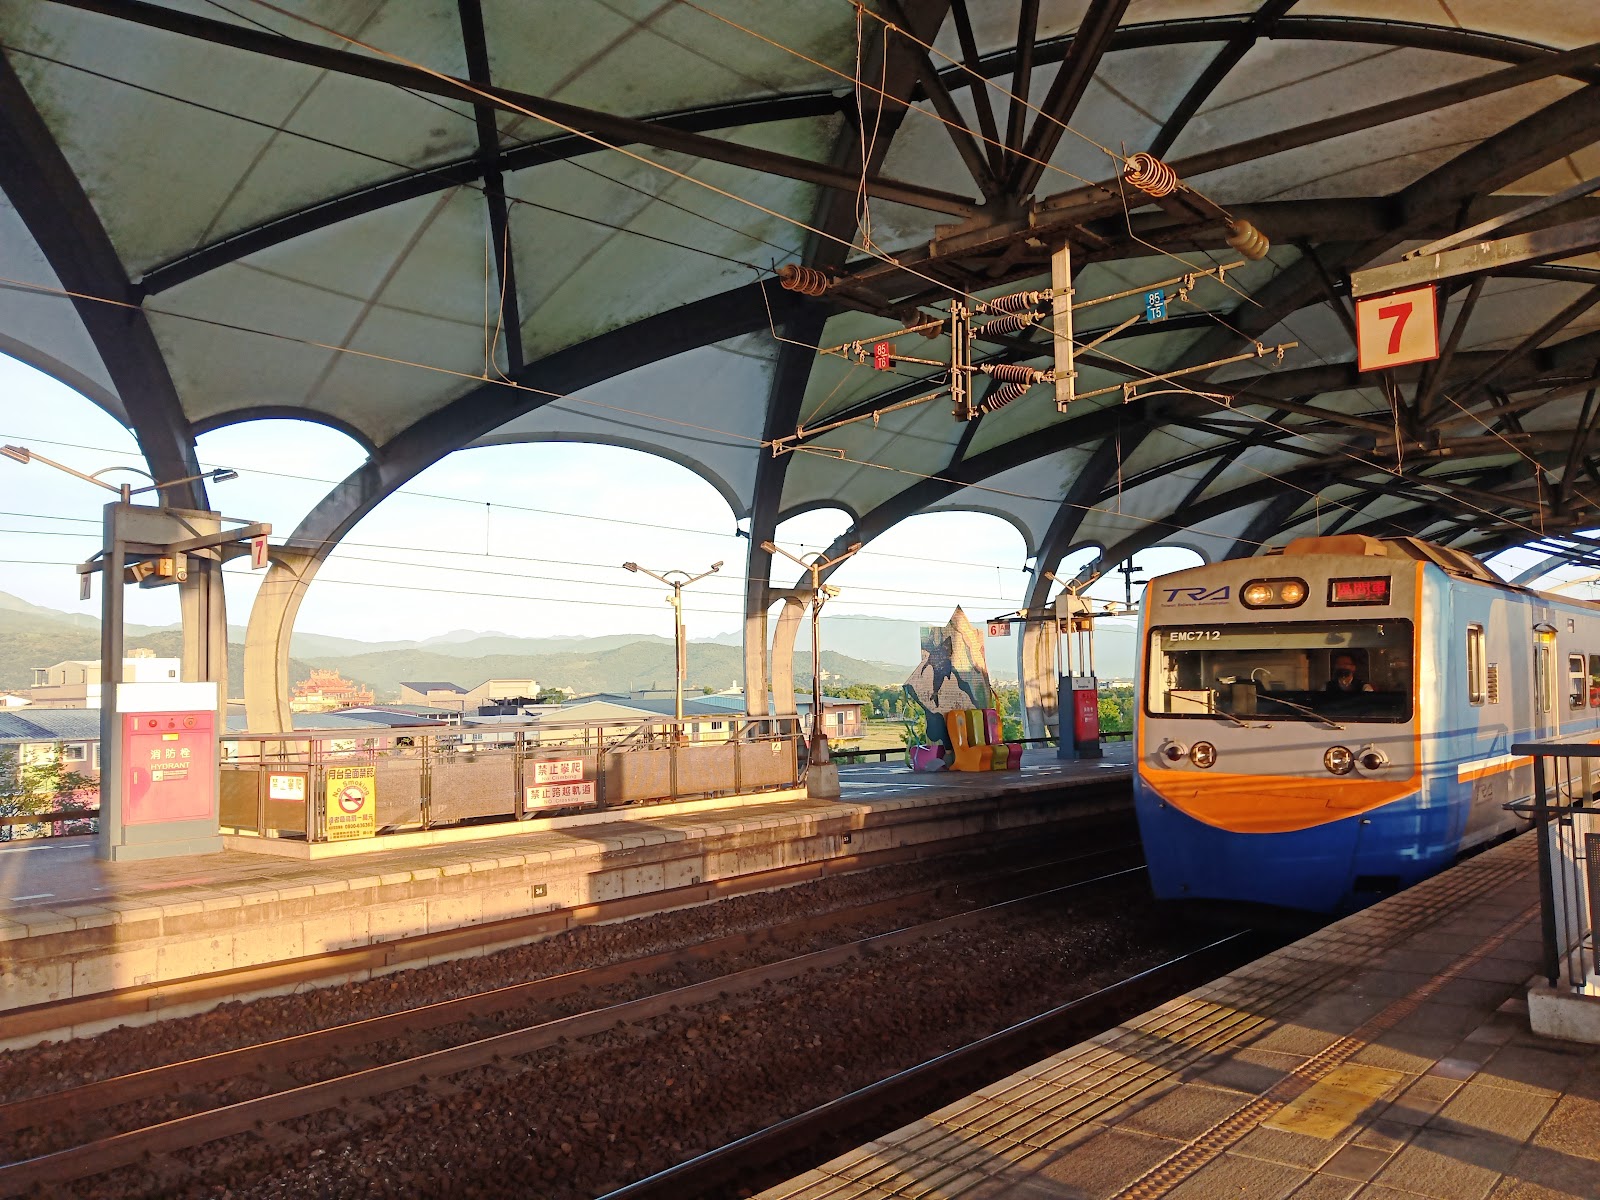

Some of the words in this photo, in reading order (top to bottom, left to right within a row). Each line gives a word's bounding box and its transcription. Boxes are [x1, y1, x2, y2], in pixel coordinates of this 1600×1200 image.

[1149, 292, 1161, 305] 85
[1150, 306, 1162, 319] T5
[1379, 302, 1413, 355] 7
[877, 344, 886, 355] 85
[255, 540, 263, 566] 7
[82, 577, 89, 597] 7
[1163, 586, 1230, 602] TRA
[990, 625, 997, 636] 6
[1170, 631, 1221, 642] EMC712
[150, 747, 191, 760] 消防栓
[150, 761, 191, 770] HYDRANT
[342, 780, 370, 796] Smoking
[530, 784, 591, 800] 禁止跨越軌道
